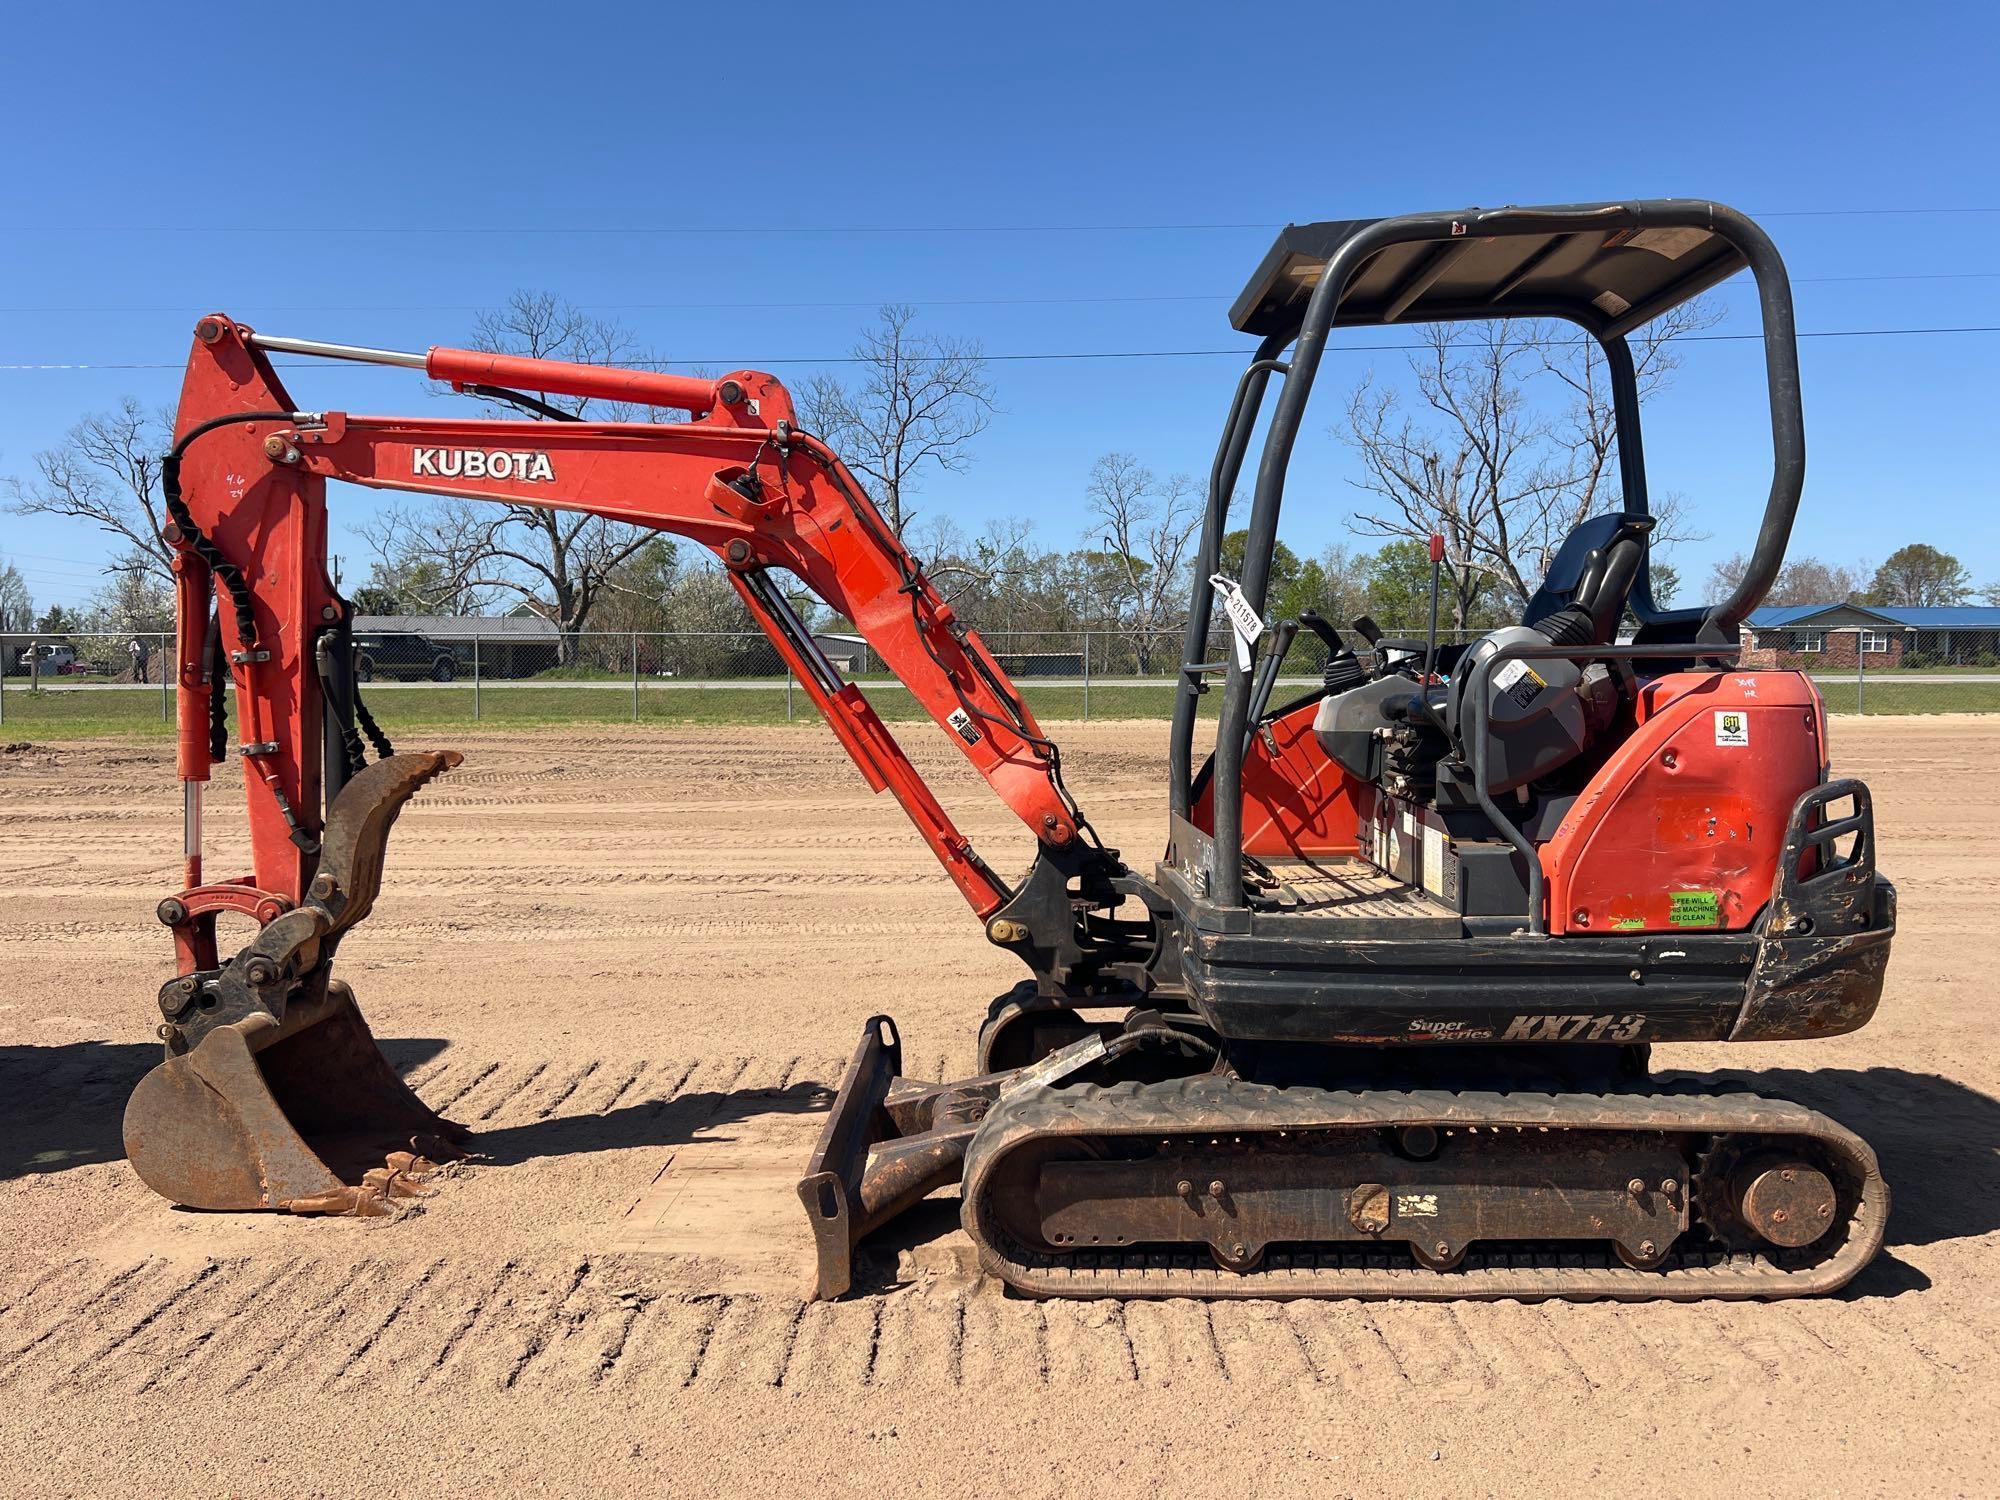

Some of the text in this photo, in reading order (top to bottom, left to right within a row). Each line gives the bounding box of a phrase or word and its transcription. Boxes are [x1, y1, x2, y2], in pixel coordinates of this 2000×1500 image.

[413, 448, 555, 481] KUBOTA
[1233, 599, 1257, 632] 211578
[1724, 716, 1739, 727] 811
[1408, 1018, 1466, 1034] Super
[1436, 1029, 1493, 1040] Series
[1501, 1013, 1647, 1041] KX71-3
